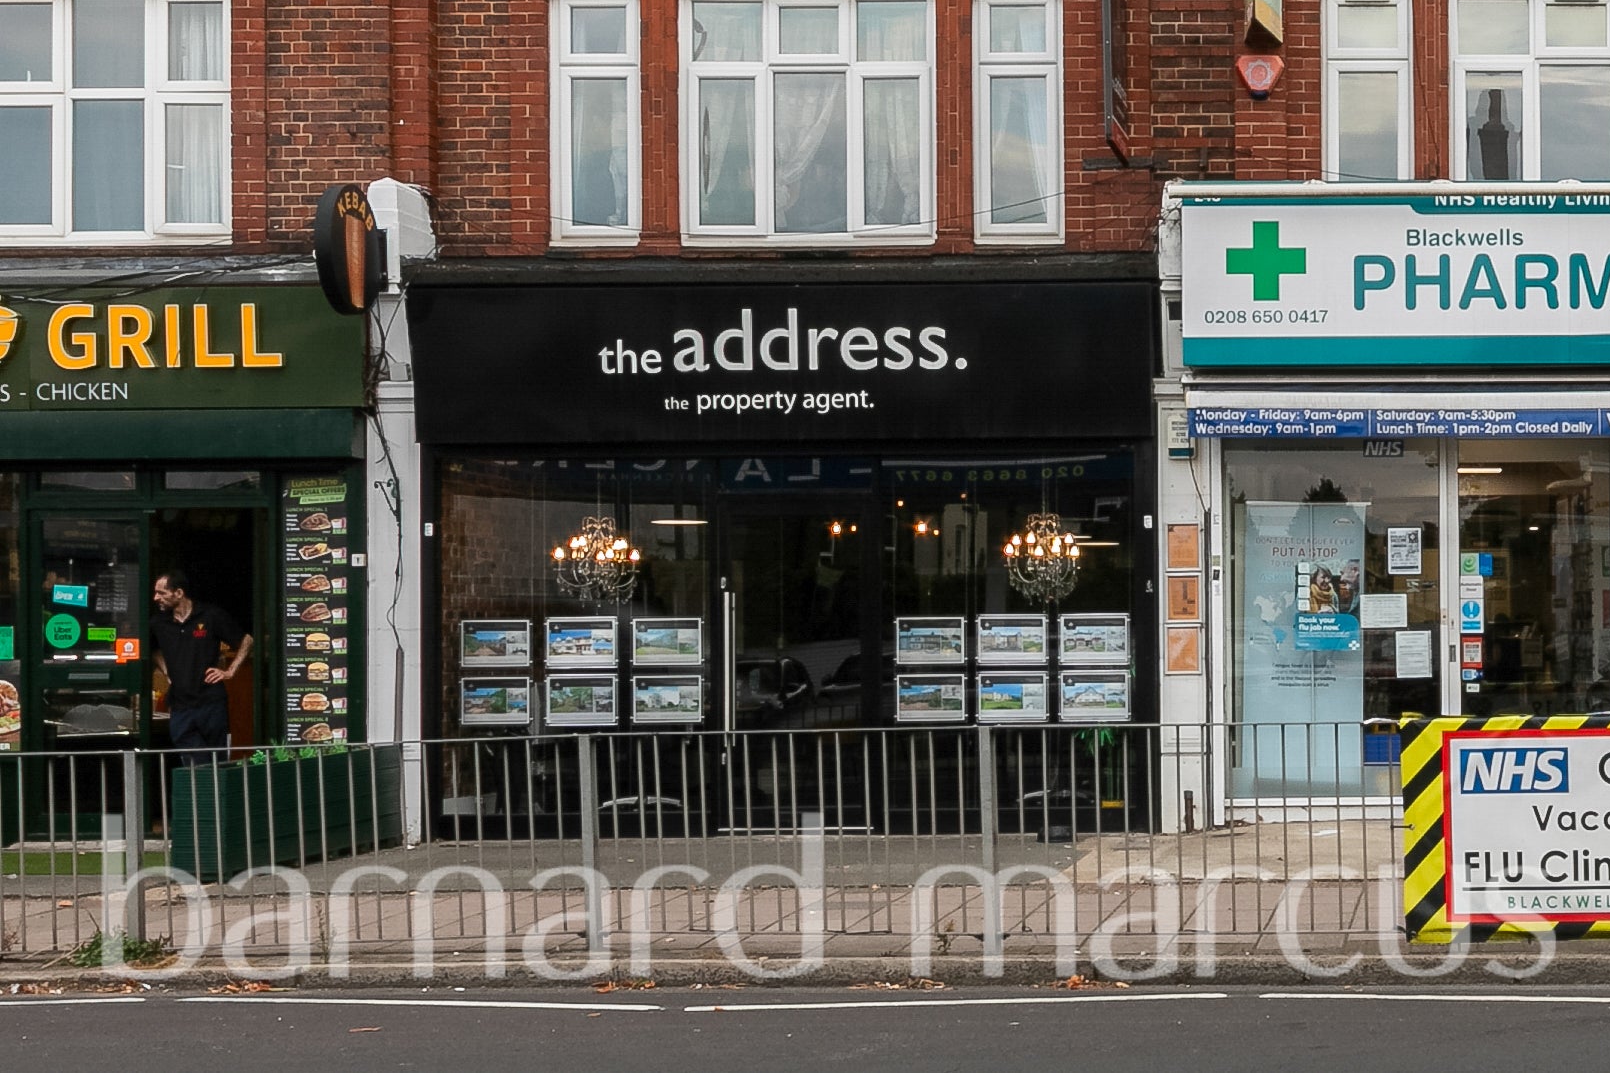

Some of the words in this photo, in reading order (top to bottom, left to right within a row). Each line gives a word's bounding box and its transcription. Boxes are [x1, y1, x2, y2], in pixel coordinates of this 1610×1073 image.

[337, 191, 374, 231] KEBAB
[1407, 228, 1524, 247] Blackwells
[1205, 310, 1247, 324] 0208
[1252, 310, 1283, 324] 650
[1288, 309, 1328, 323] 0417
[48, 303, 283, 370] GRILL
[598, 339, 662, 374] the
[673, 308, 968, 373] address.
[36, 383, 128, 401] CHICKEN
[664, 395, 689, 411] the
[696, 391, 797, 414] property
[802, 389, 875, 414] agent.
[1259, 409, 1300, 422] Friday:
[1303, 409, 1364, 422] 9am-6pm
[1376, 409, 1435, 422] Saturday:
[1438, 409, 1516, 422] 9am-5:30pm
[1195, 423, 1272, 436] Wednesday:
[1275, 423, 1336, 436] 9am-1pm
[1376, 423, 1415, 434] Lunch
[1416, 423, 1449, 434] Time:
[1452, 423, 1512, 436] 1pm-2pm
[1515, 422, 1559, 434] Closed
[1561, 421, 1593, 435] Daily
[1365, 441, 1401, 456] NHS
[1272, 547, 1295, 557] PUT
[1298, 548, 1305, 557] A
[1309, 547, 1338, 557] STOP
[1461, 749, 1566, 792] NHS
[1464, 851, 1523, 884] FLU
